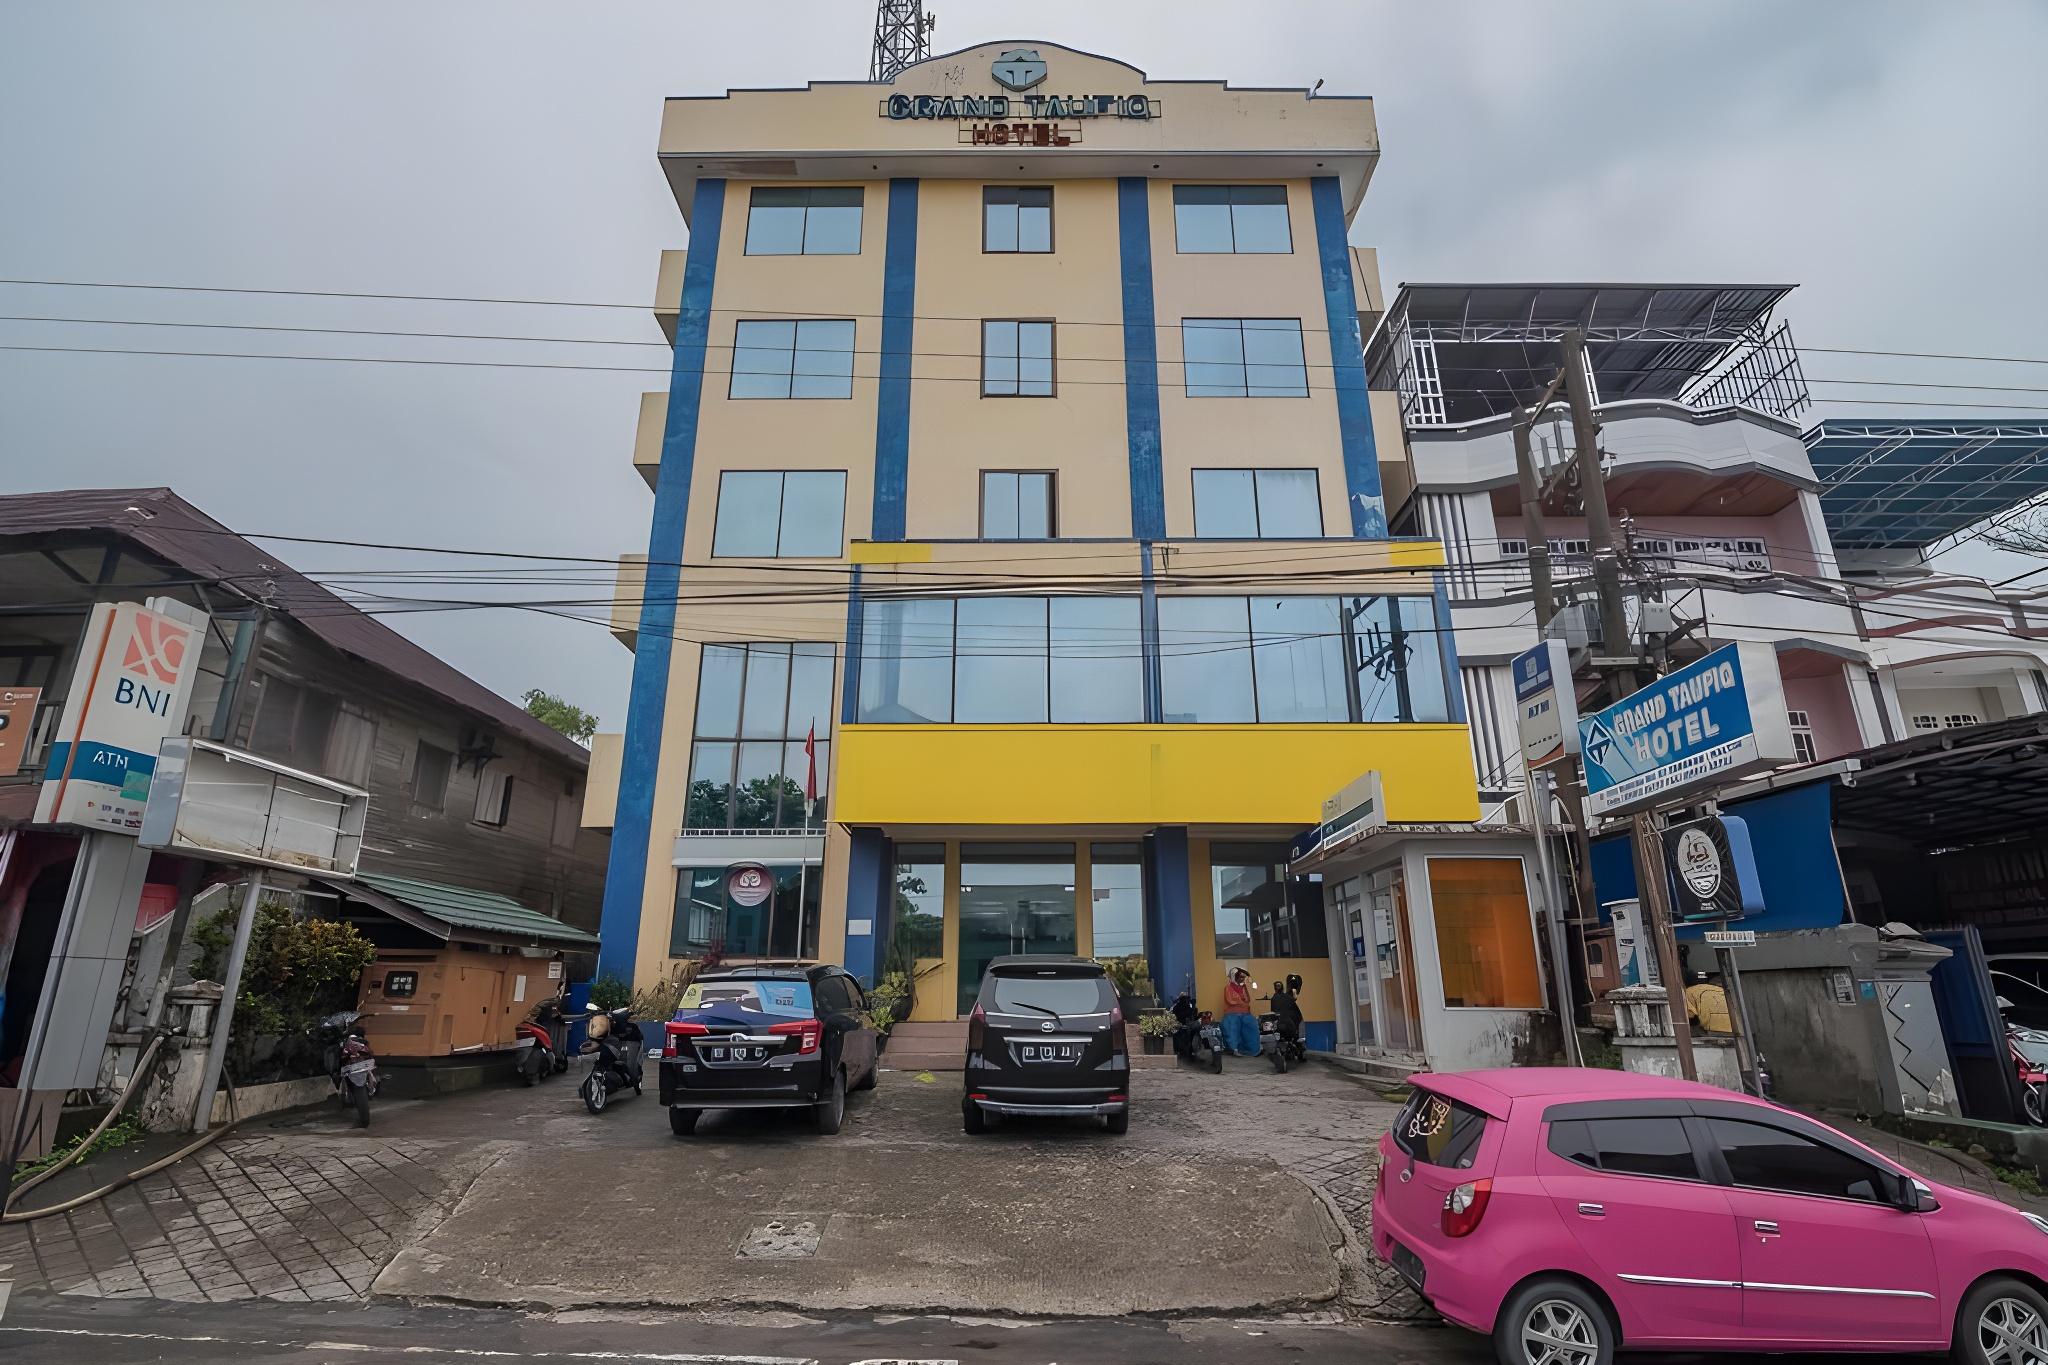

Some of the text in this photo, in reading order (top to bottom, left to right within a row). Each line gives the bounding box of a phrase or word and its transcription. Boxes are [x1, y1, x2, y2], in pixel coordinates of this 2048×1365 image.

[888, 93, 1009, 120] GRAND
[973, 122, 1070, 146] HOTEL
[115, 677, 171, 717] BNI
[1634, 706, 1720, 762] HOTEL
[93, 750, 129, 770] ATM
